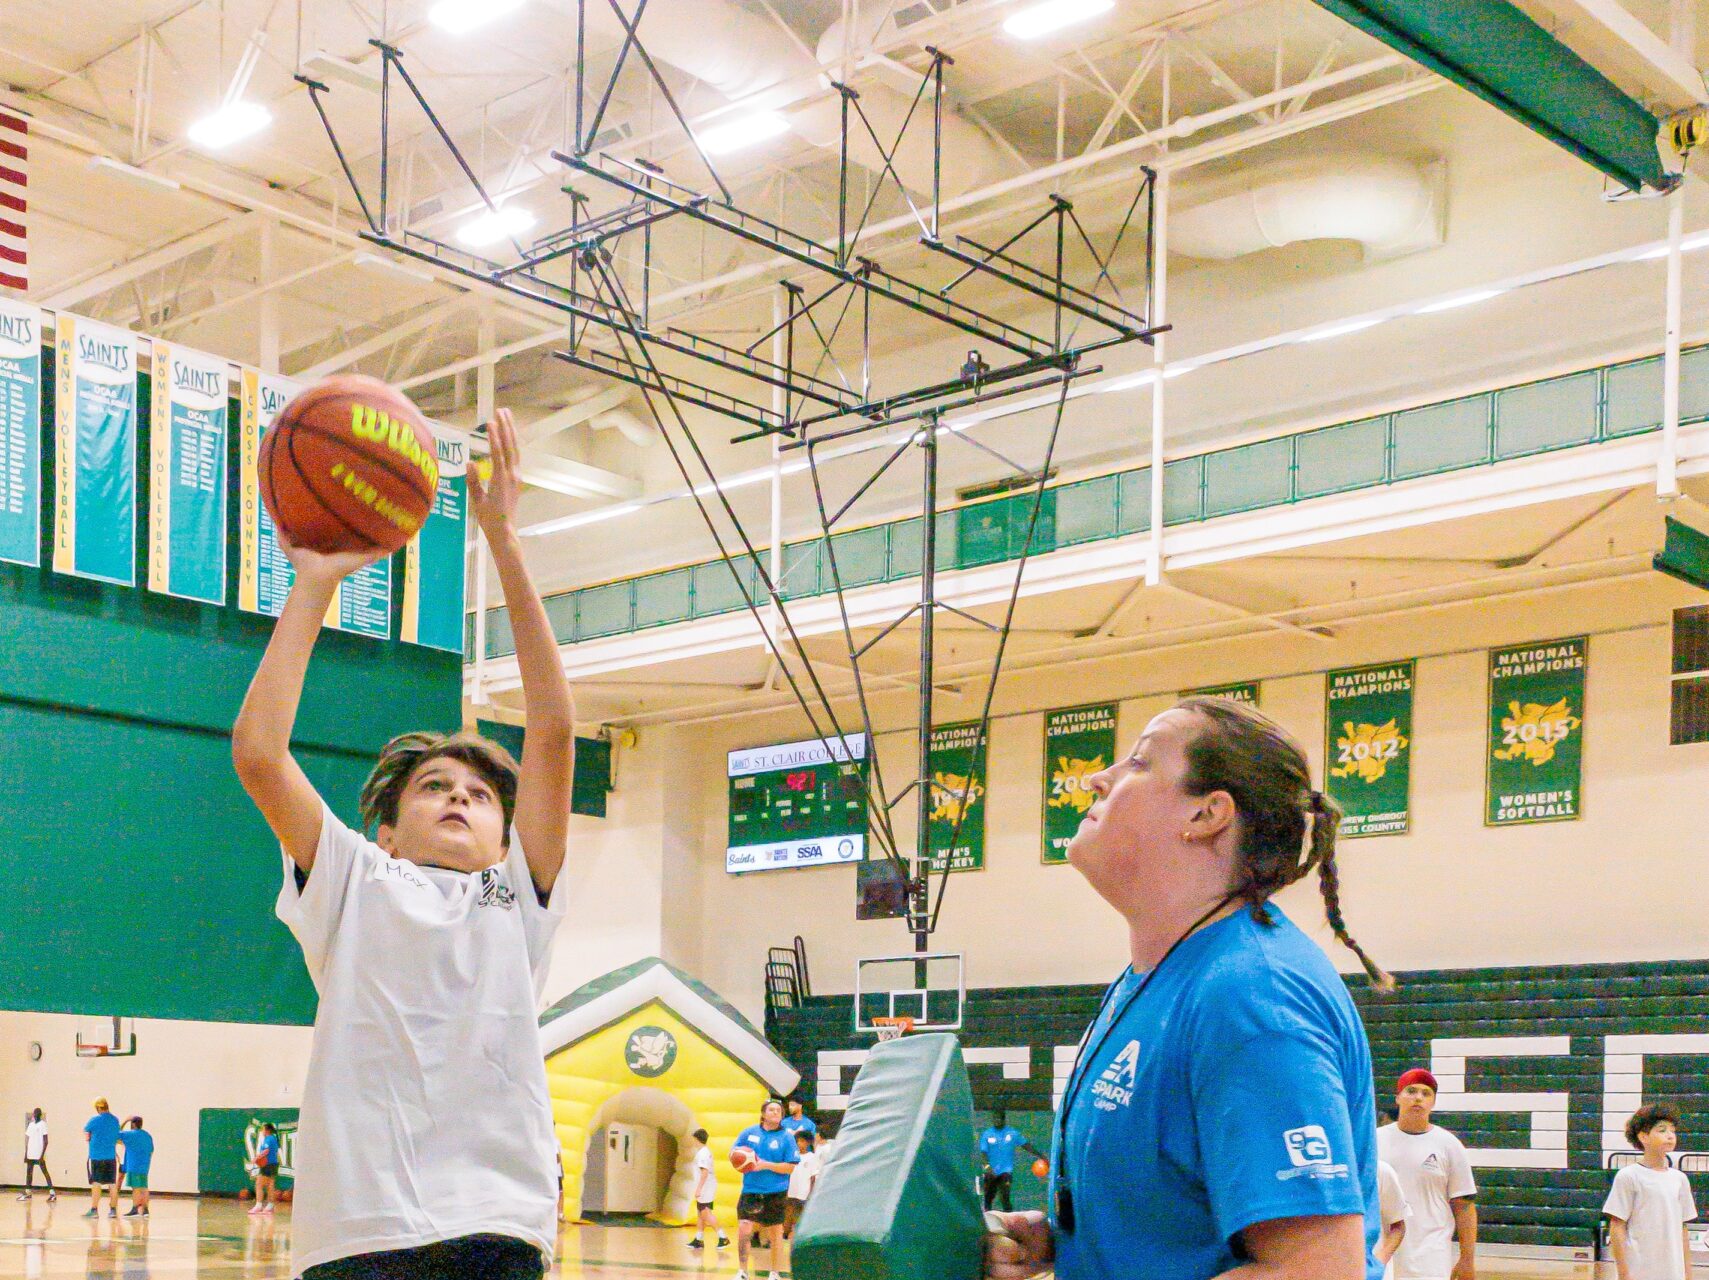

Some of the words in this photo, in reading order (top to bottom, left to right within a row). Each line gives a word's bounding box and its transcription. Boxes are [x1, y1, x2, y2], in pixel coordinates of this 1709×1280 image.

[0, 312, 32, 344] INTS
[78, 334, 129, 371] SAINTS
[60, 339, 71, 394] MENS
[173, 360, 221, 396] SAINTS
[154, 352, 167, 433] WOMENS
[246, 394, 255, 467] CROSS
[60, 410, 71, 549] VOLLEYBALL
[155, 449, 166, 583] VOLLEYBALL
[245, 484, 255, 586] COUNTRY
[1498, 645, 1577, 665] NATIONAL
[1334, 669, 1406, 687] NATIONAL
[1492, 656, 1584, 679] CHAMPIONS
[1329, 679, 1411, 700] CHAMPIONS
[1047, 718, 1115, 737] CHAMPIONS
[1051, 709, 1111, 725] NATIONAL
[1502, 719, 1569, 745] 2015
[772, 750, 807, 766] CLAIR
[1338, 738, 1399, 763] 2012
[1499, 790, 1573, 807] WOMEN'S
[1497, 803, 1574, 820] SOFTBALL
[1361, 820, 1407, 833] COUNTRY
[728, 852, 755, 866] Saints
[797, 845, 823, 859] SSAA
[1091, 1078, 1134, 1108] SPARK
